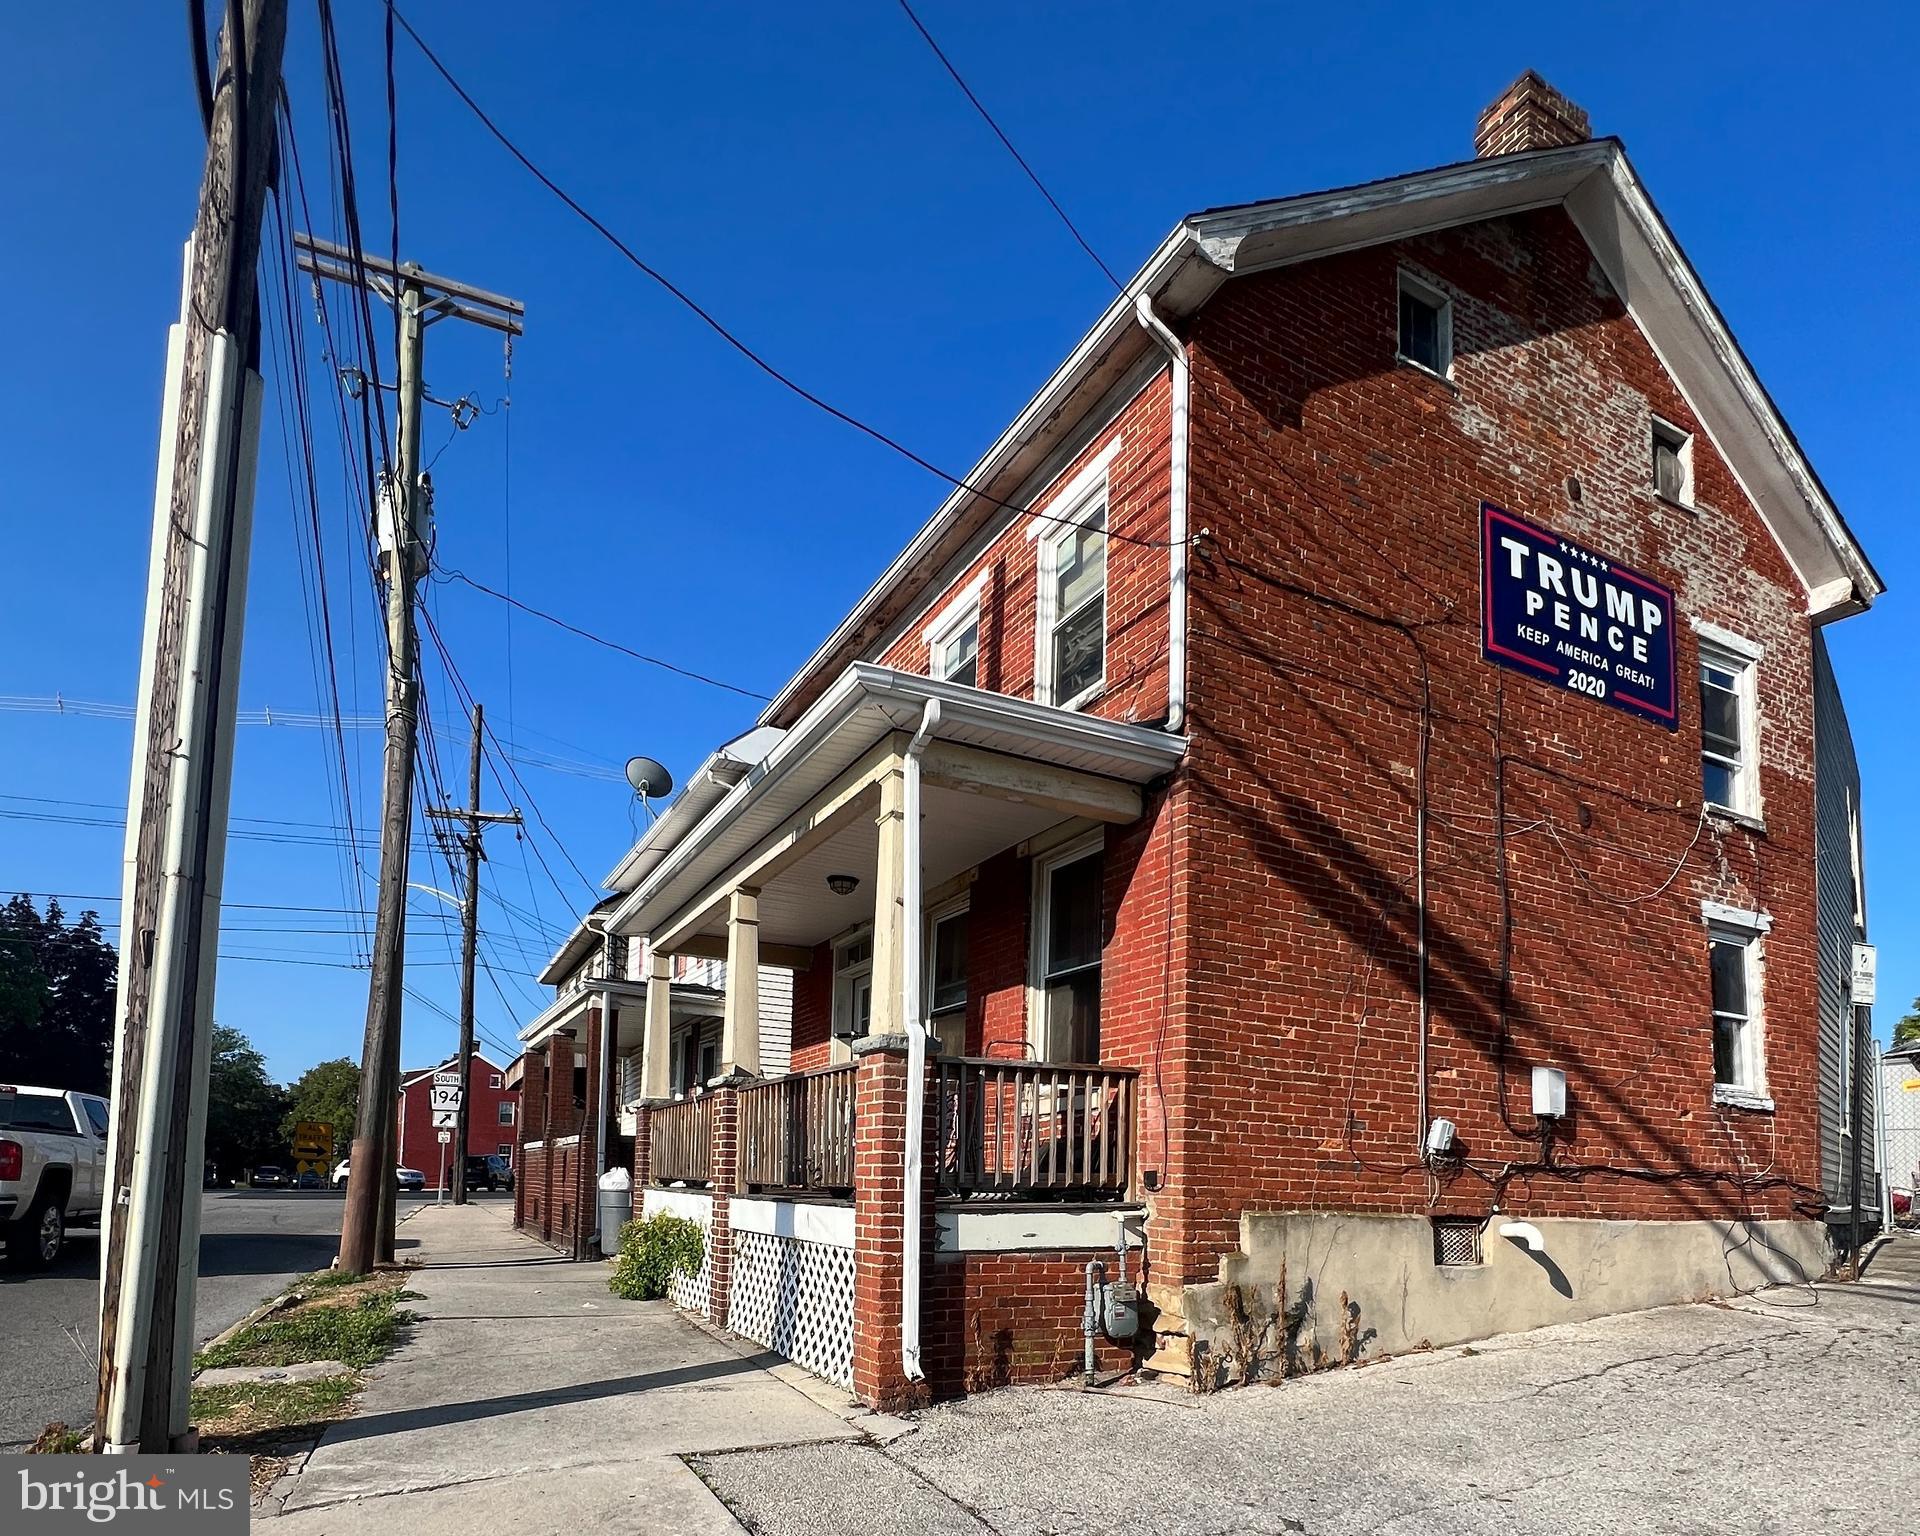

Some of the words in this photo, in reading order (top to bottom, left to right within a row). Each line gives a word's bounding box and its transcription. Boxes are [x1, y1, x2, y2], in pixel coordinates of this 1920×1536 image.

[1500, 536, 1662, 635] TRUMP
[1526, 590, 1648, 664] PENCE
[1517, 623, 1550, 646] KEEP
[1556, 640, 1609, 671] AMERICA
[1615, 664, 1655, 690] GREAT!
[1567, 668, 1606, 698] 2020
[433, 1090, 460, 1105] 194
[435, 1073, 459, 1083] SOUTH
